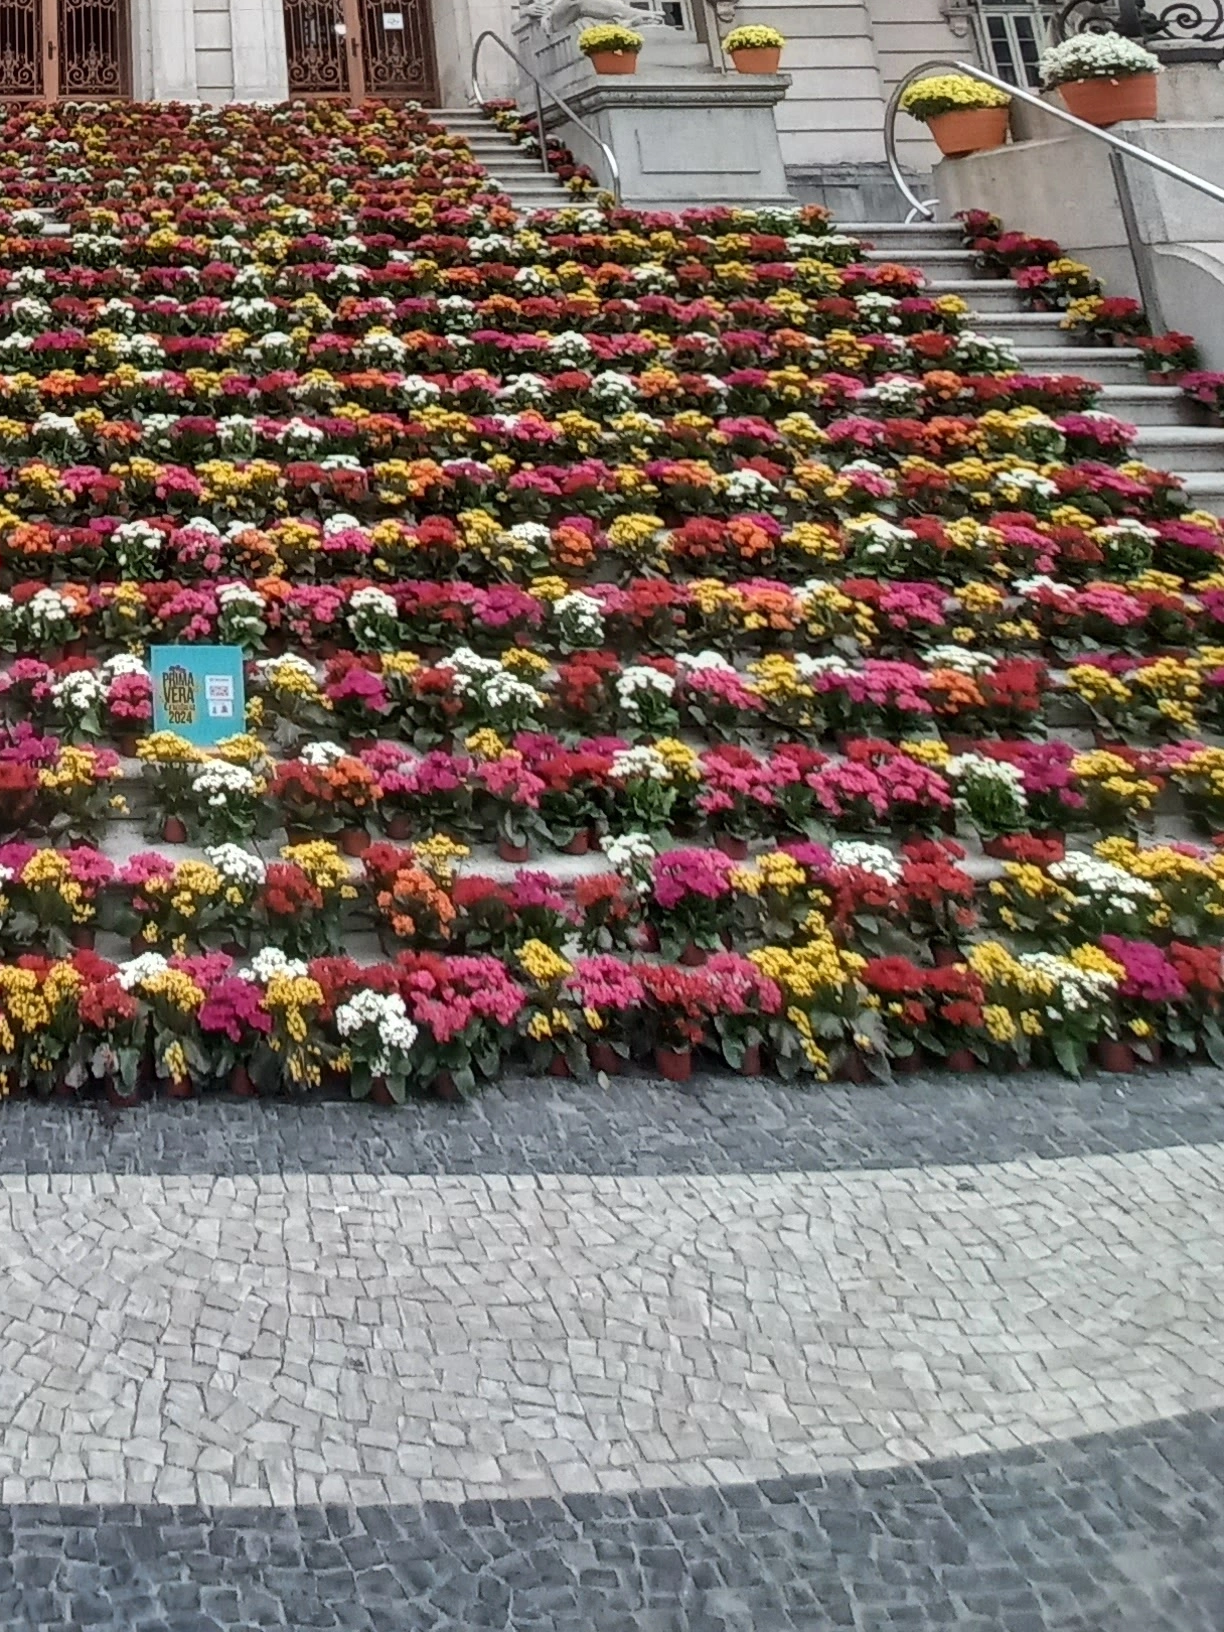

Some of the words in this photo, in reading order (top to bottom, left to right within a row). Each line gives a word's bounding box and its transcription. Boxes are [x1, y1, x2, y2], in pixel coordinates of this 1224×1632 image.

[162, 671, 195, 687] PRIMA
[163, 686, 195, 704] VERA
[168, 710, 193, 724] 2024
